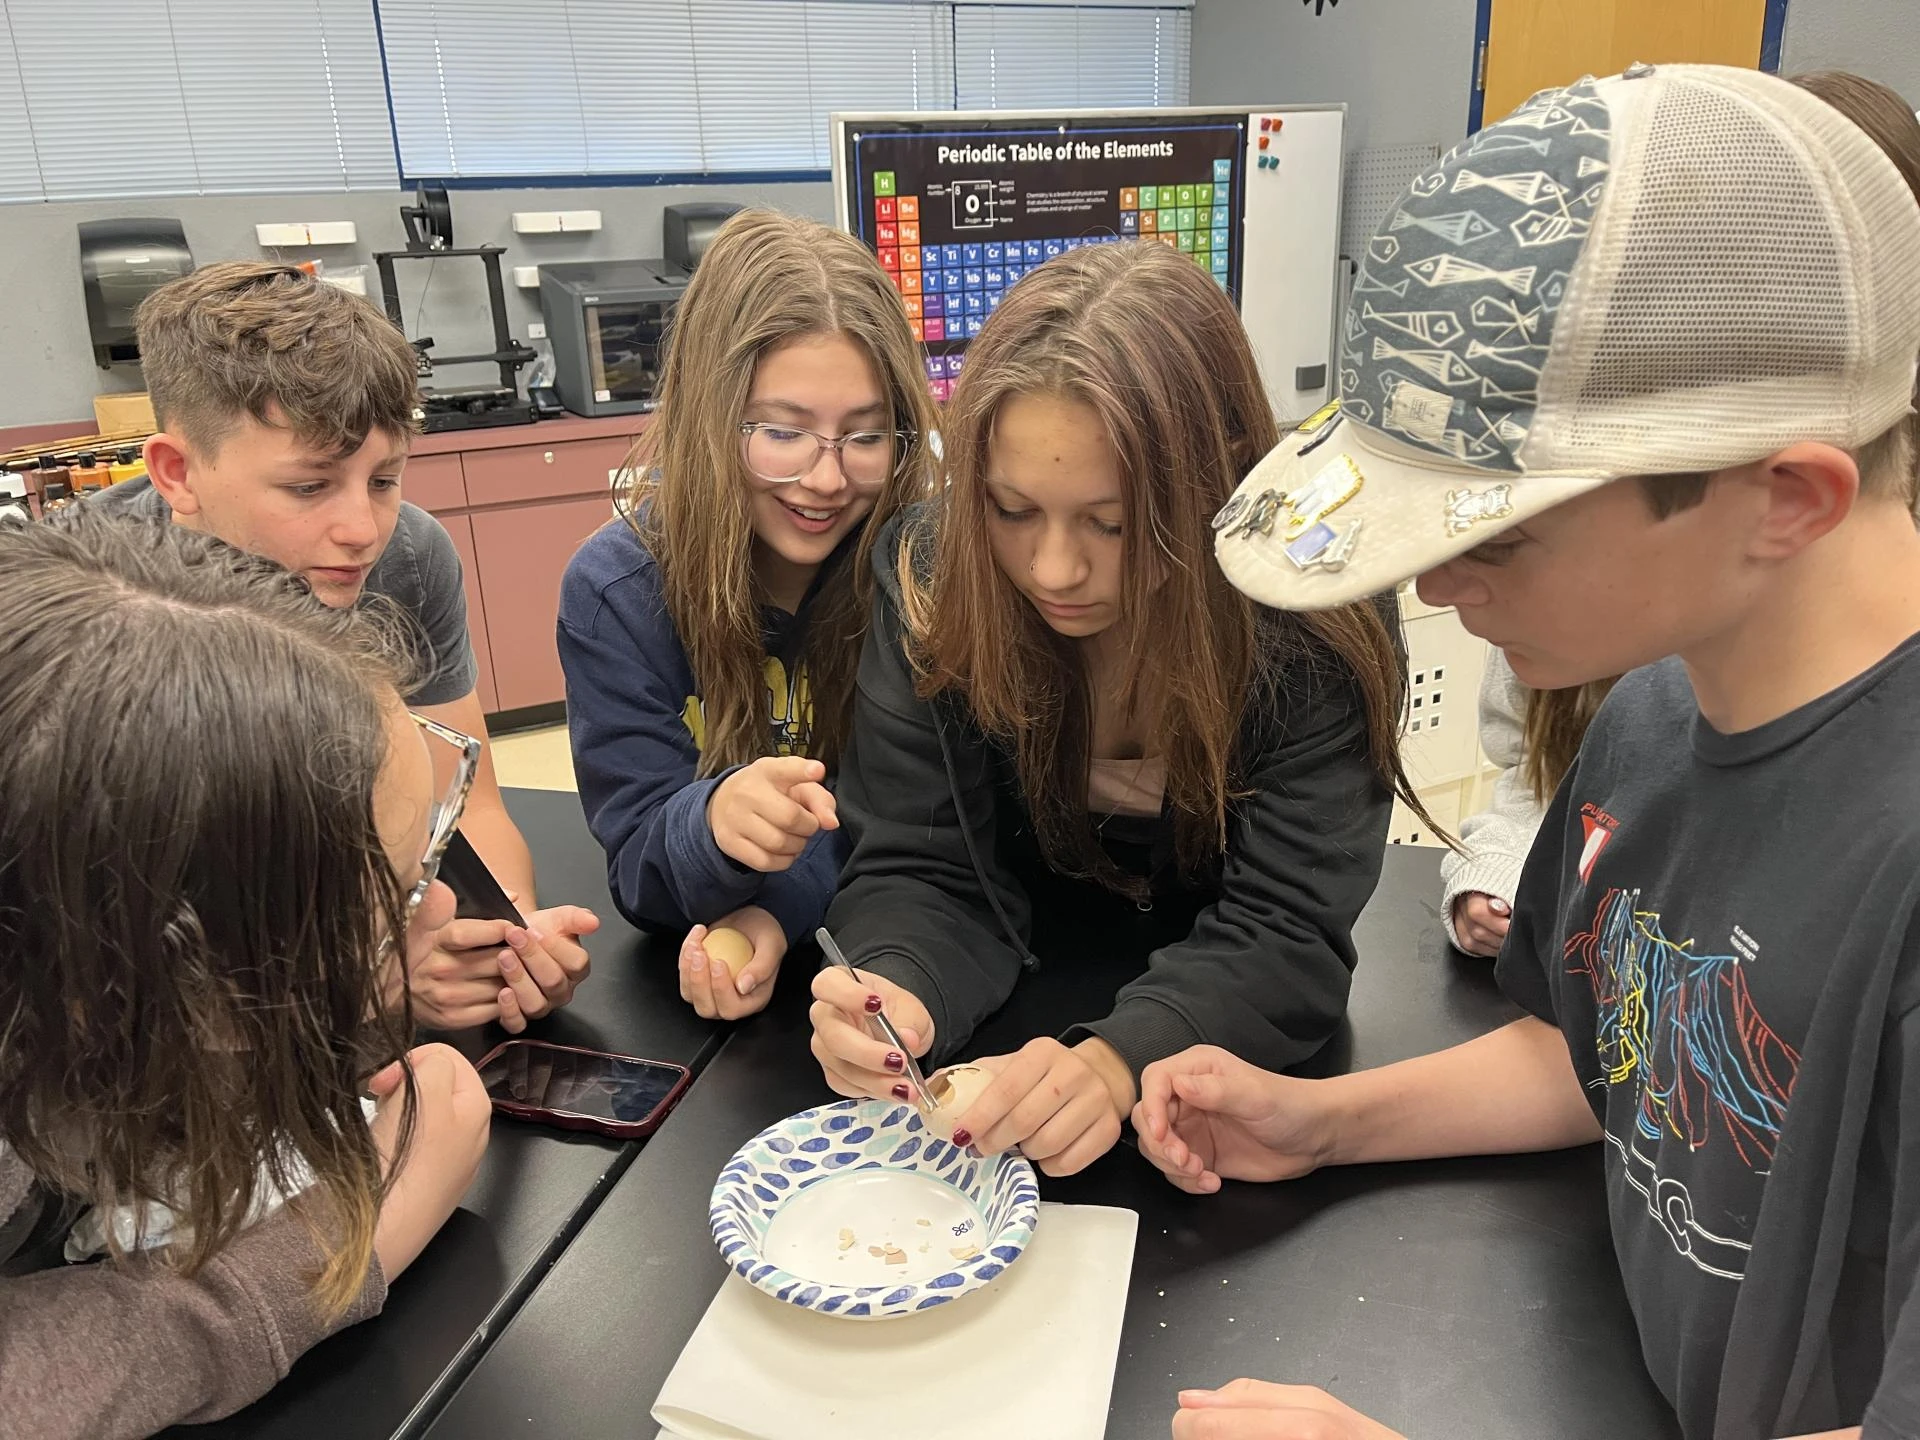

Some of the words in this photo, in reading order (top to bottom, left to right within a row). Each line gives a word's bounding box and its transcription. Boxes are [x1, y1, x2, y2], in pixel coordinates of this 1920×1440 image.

[938, 143, 1006, 164] Periodic
[1008, 143, 1052, 162] Table
[1055, 142, 1073, 160] of
[1074, 142, 1101, 159] the
[1104, 140, 1174, 158] Elements
[880, 178, 889, 189] H
[954, 185, 961, 195] 8
[1125, 194, 1133, 203] B
[1144, 192, 1152, 202] C
[1162, 192, 1170, 201] N
[1181, 191, 1190, 200] O
[1201, 189, 1208, 199] F
[881, 202, 891, 214] Li
[901, 202, 914, 213] Be
[965, 194, 980, 213] O
[1124, 216, 1134, 227] Al
[1143, 215, 1153, 225] Si
[1163, 215, 1170, 224] P
[1183, 213, 1190, 223] S
[1199, 212, 1208, 222] Cl
[880, 229, 894, 239] Na
[884, 254, 892, 264] K
[903, 253, 916, 263] Ca
[926, 252, 937, 262] Sc
[947, 250, 957, 260] Ti
[968, 250, 977, 259] V
[988, 248, 1000, 258] Cr
[1006, 247, 1020, 257] Mn
[1027, 246, 1039, 256] Fe
[1046, 245, 1060, 255] Co
[905, 277, 917, 288] Sr
[928, 275, 936, 286] Y
[947, 275, 959, 286] Zr
[966, 273, 980, 283] Nb
[987, 272, 1002, 282] Mo
[1009, 271, 1019, 281] Tc
[948, 298, 960, 309] Hf
[968, 297, 980, 308] Ta
[949, 322, 960, 332] Rf
[968, 320, 981, 331] Db
[930, 362, 942, 372] La
[950, 360, 962, 370] Ce
